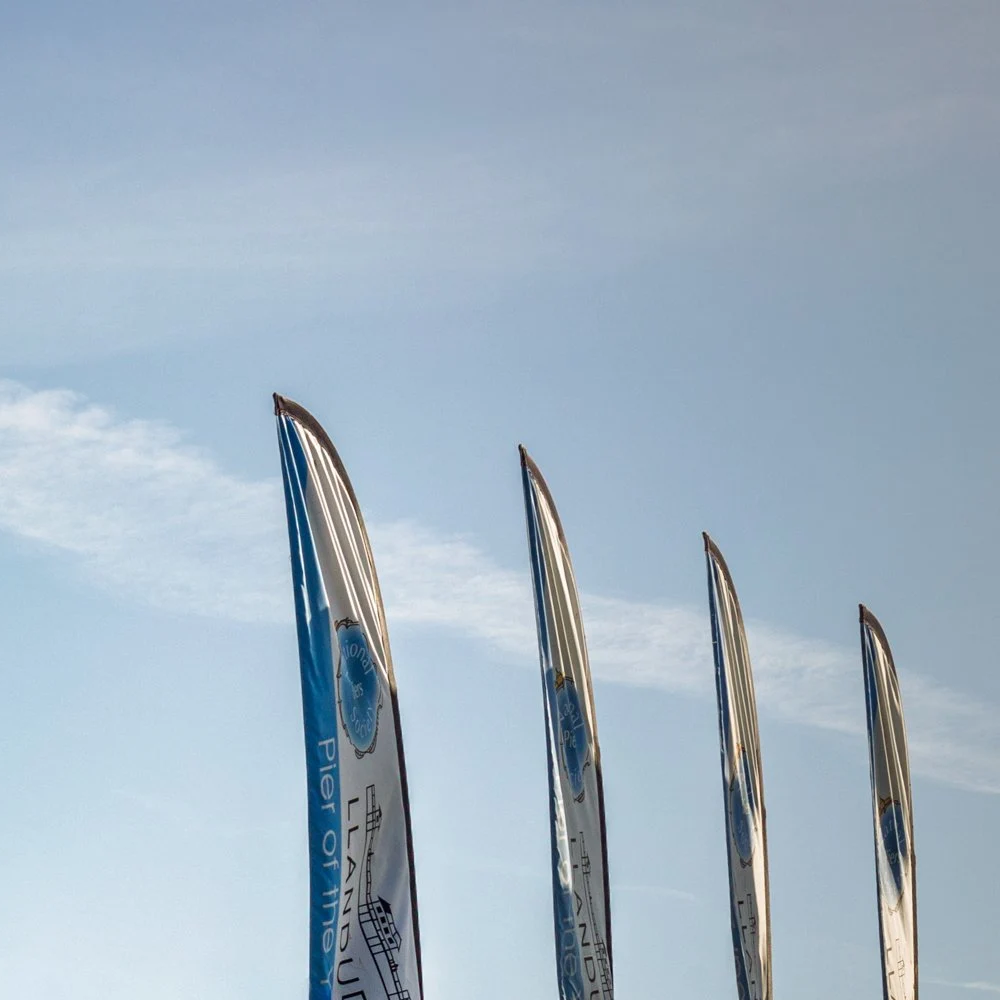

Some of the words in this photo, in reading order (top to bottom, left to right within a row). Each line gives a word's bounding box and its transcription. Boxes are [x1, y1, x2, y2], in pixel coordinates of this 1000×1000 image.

[318, 738, 337, 815] Pier
[322, 830, 340, 872] of
[322, 887, 339, 954] the
